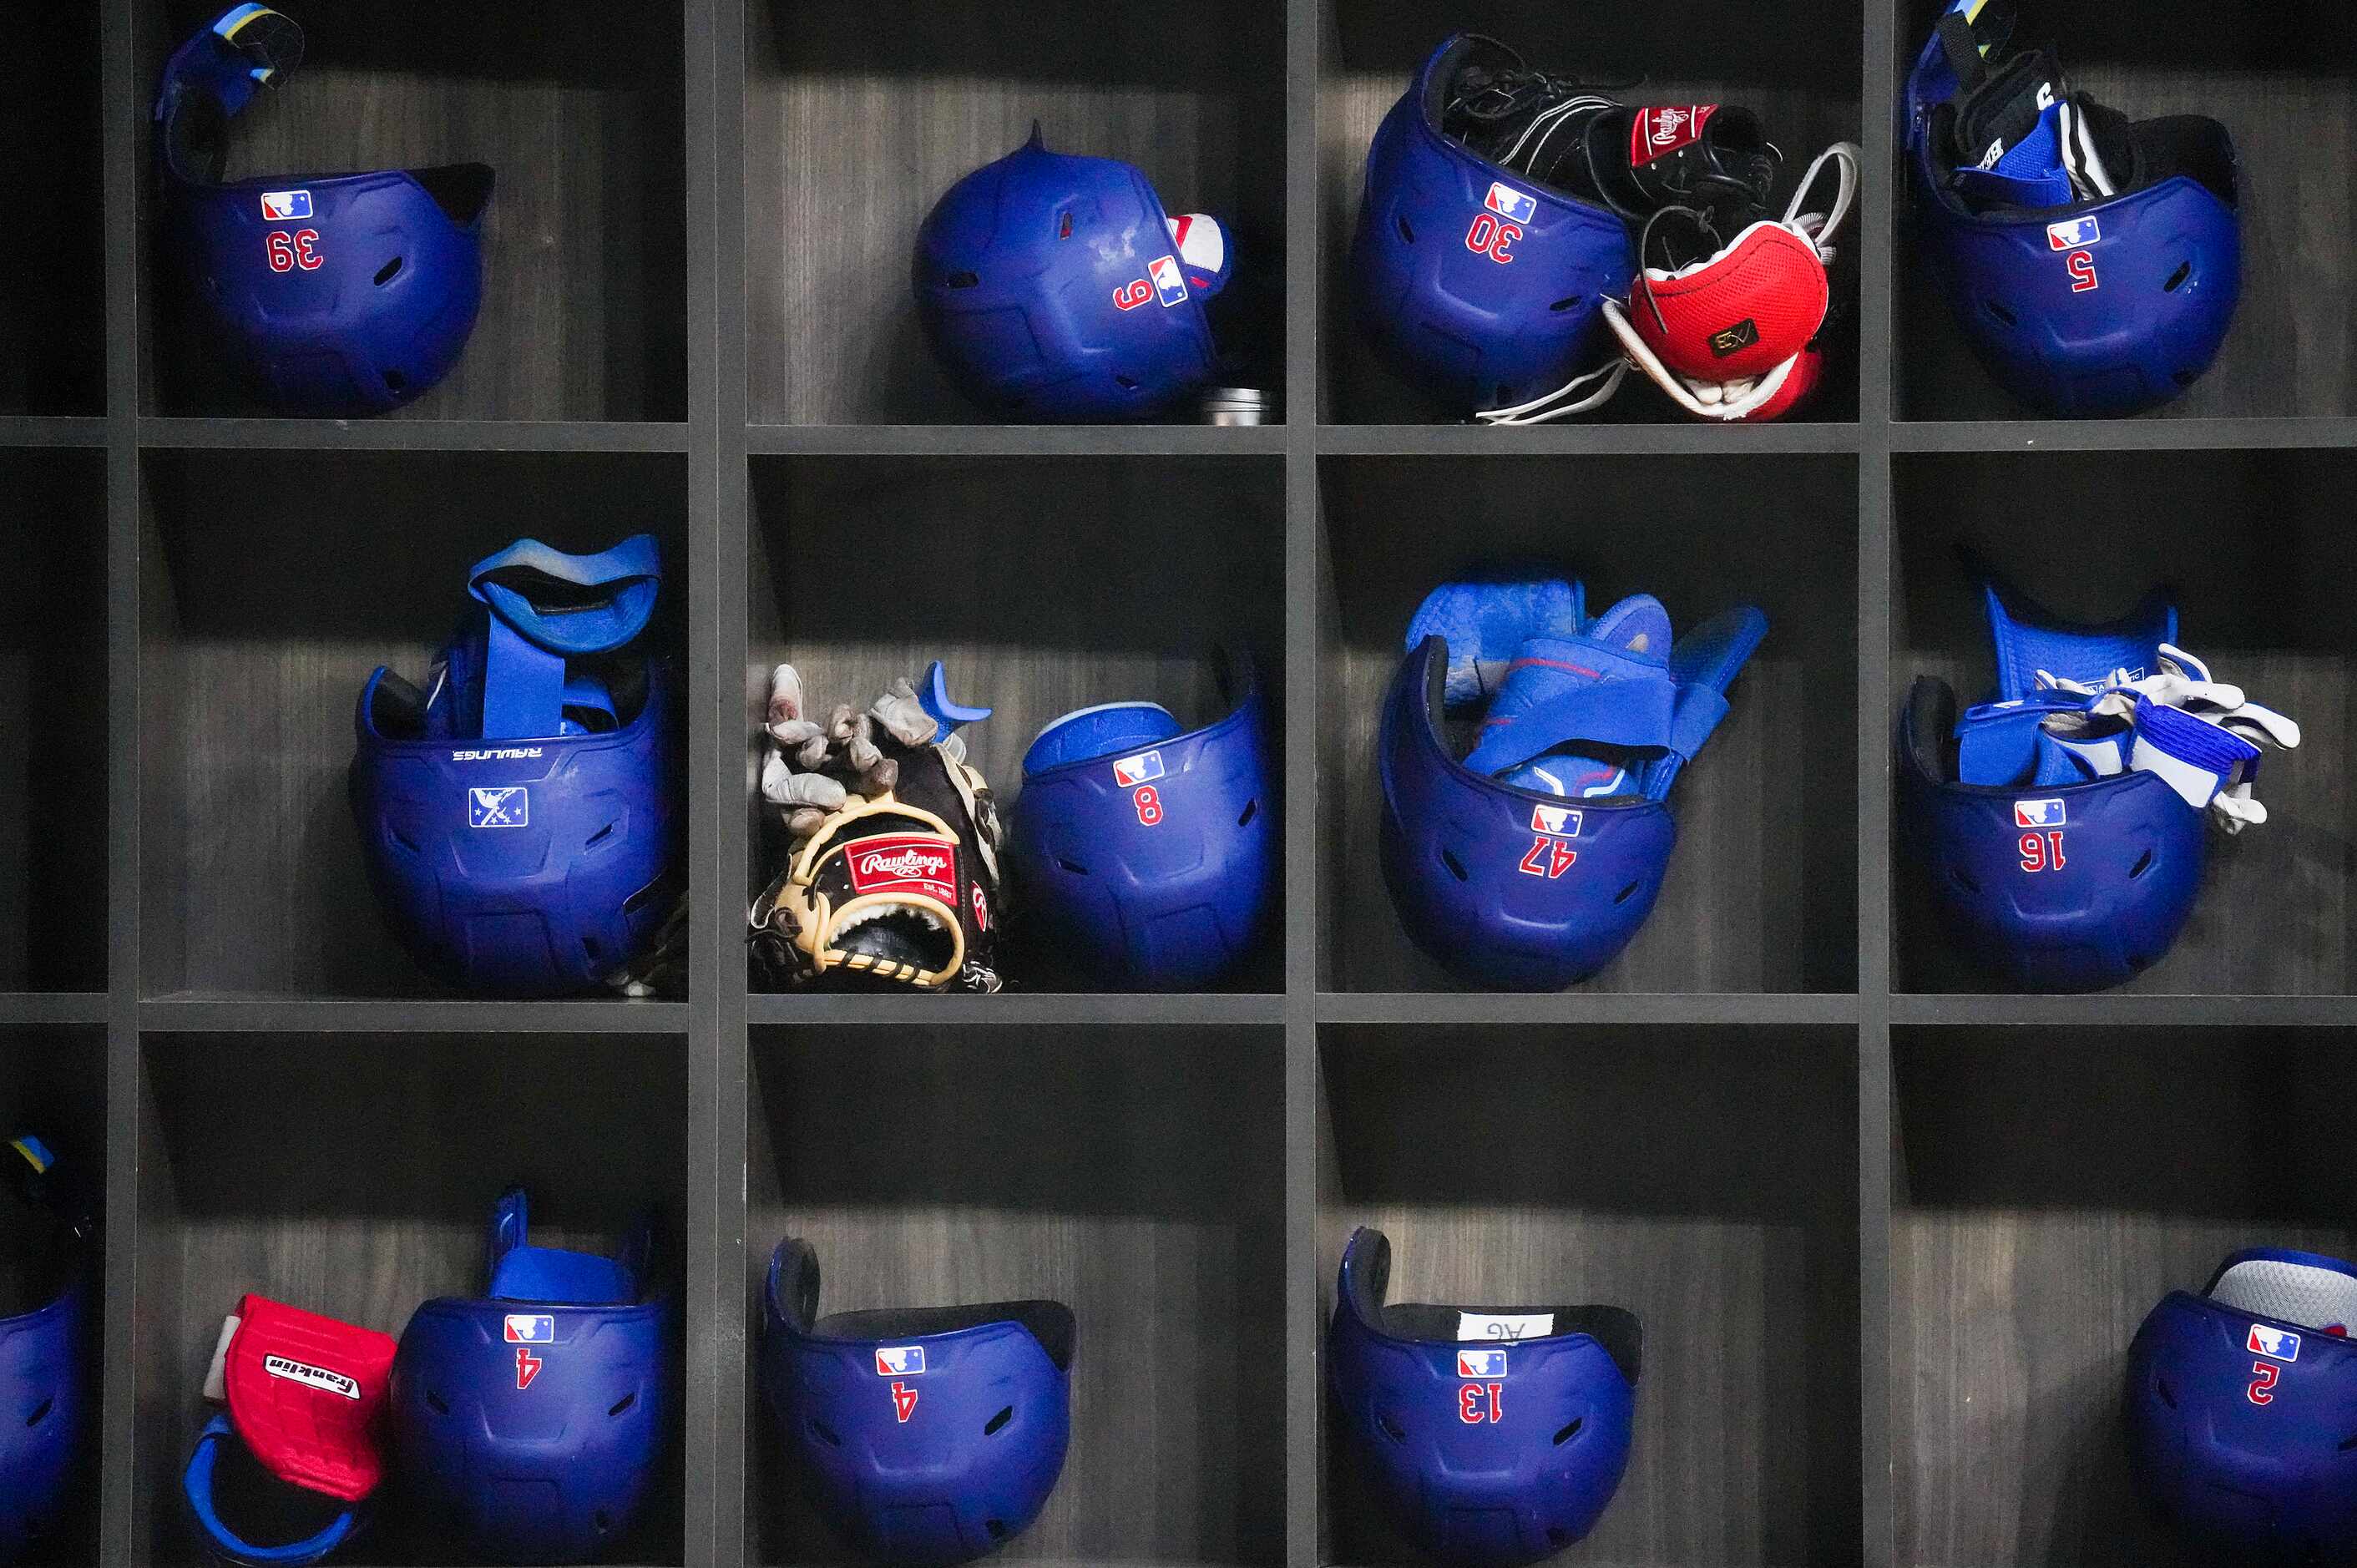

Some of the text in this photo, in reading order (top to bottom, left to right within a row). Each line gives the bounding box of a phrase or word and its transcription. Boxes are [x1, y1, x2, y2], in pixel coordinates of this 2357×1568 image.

[266, 228, 323, 272] 39
[1464, 213, 1523, 265] 30
[2066, 250, 2098, 292] 5
[1112, 278, 1155, 311] 6
[452, 748, 543, 761] RAWLINGS
[1132, 785, 1163, 827] 8
[861, 849, 947, 876] Rawlings
[1518, 836, 1577, 878] 47
[2018, 831, 2066, 872] 16
[1487, 1323, 1525, 1340] AG
[516, 1348, 543, 1389] 4
[2247, 1361, 2281, 1405] 2
[891, 1381, 918, 1424] 4
[1459, 1383, 1503, 1424] 13
